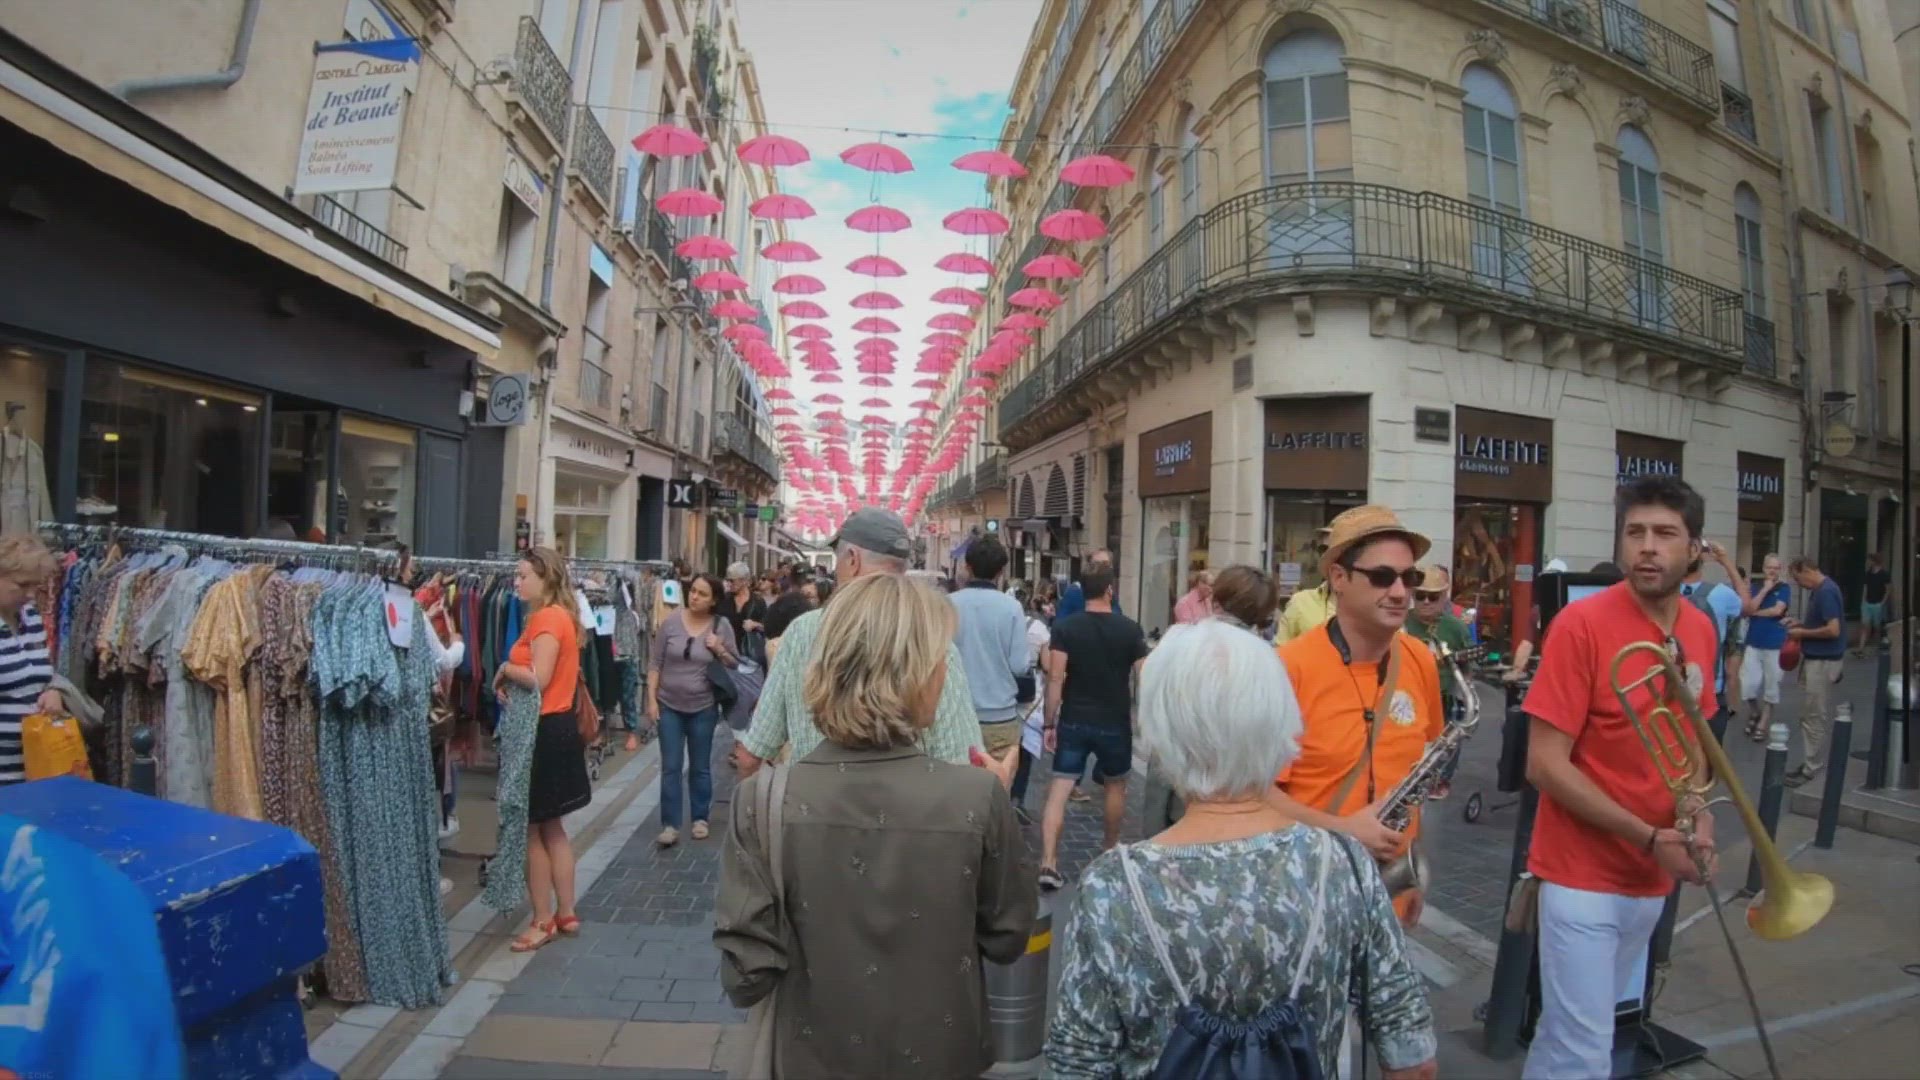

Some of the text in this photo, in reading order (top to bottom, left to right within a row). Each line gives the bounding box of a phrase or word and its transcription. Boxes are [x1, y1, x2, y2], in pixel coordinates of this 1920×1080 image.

[322, 82, 391, 109] Institut
[307, 96, 401, 131] de Beauté
[334, 162, 373, 176] Lifting
[1267, 431, 1368, 450] LAFFITE
[1460, 433, 1548, 464] LAFFITE
